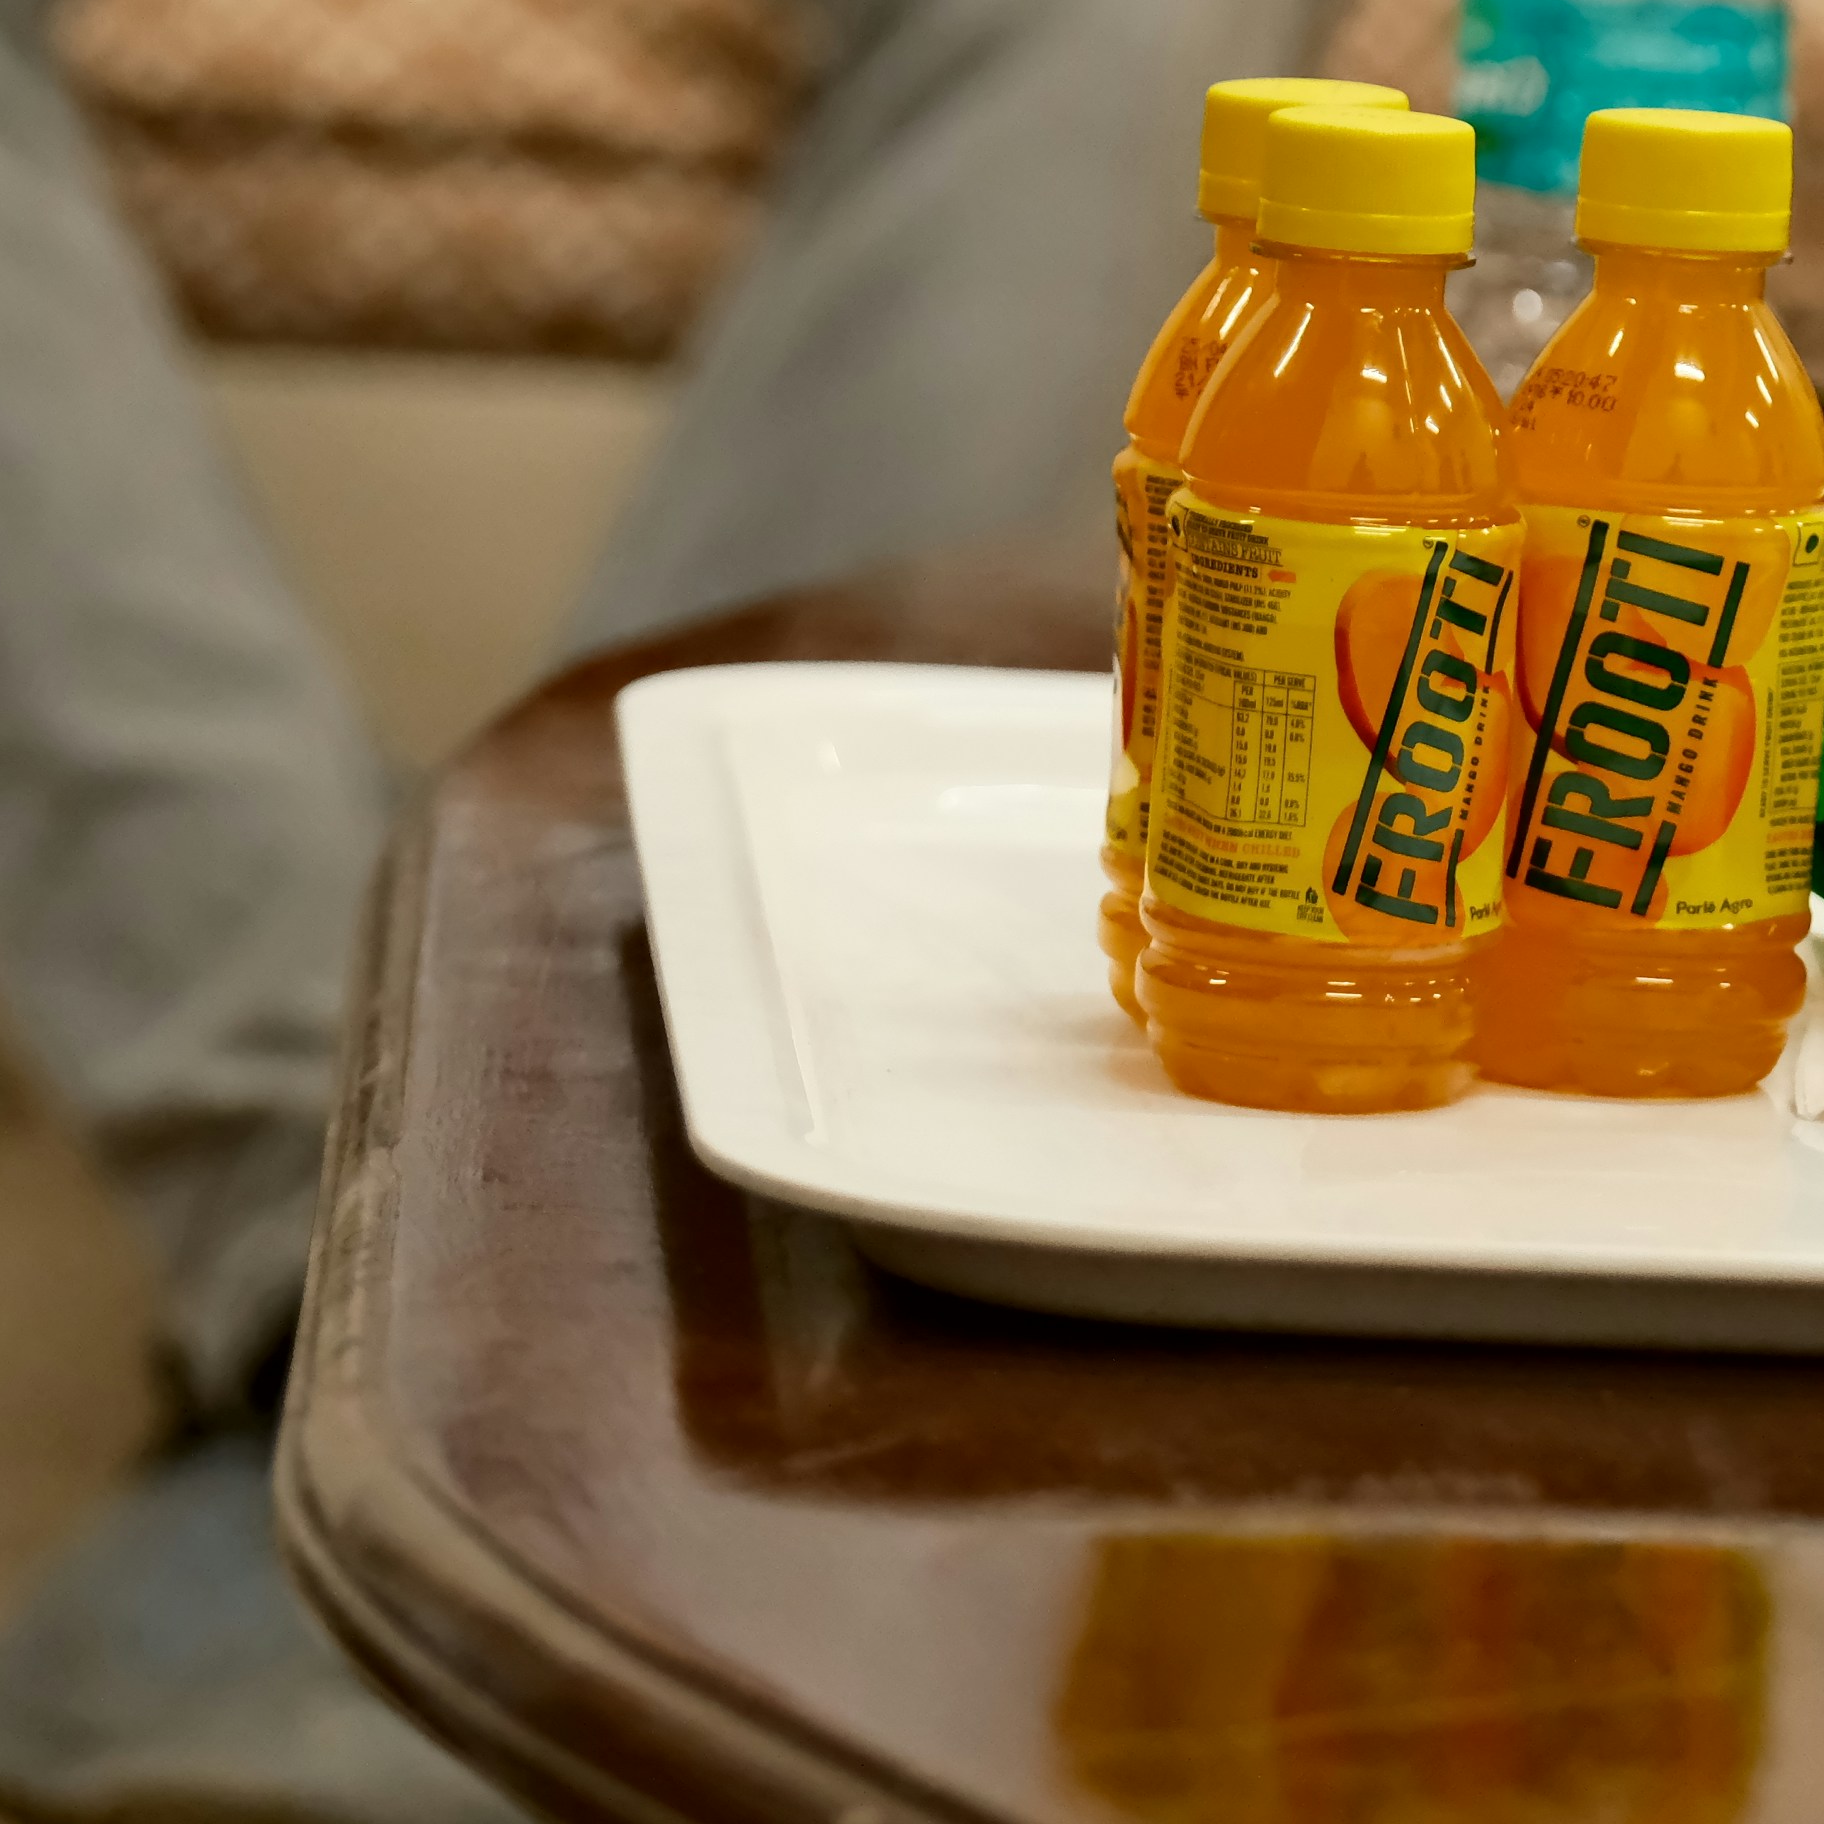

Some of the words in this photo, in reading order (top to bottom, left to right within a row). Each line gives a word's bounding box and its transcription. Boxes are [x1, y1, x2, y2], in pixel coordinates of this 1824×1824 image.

[1242, 545, 1282, 564] FRUIT
[1355, 550, 1504, 924] FROOTI
[1459, 756, 1480, 821] MANGO
[1474, 685, 1490, 747] DRINK
[1524, 530, 1724, 909] FROOTI
[1666, 749, 1698, 815] MANGO
[1687, 677, 1718, 741] DRINK
[1719, 897, 1754, 915] Agro
